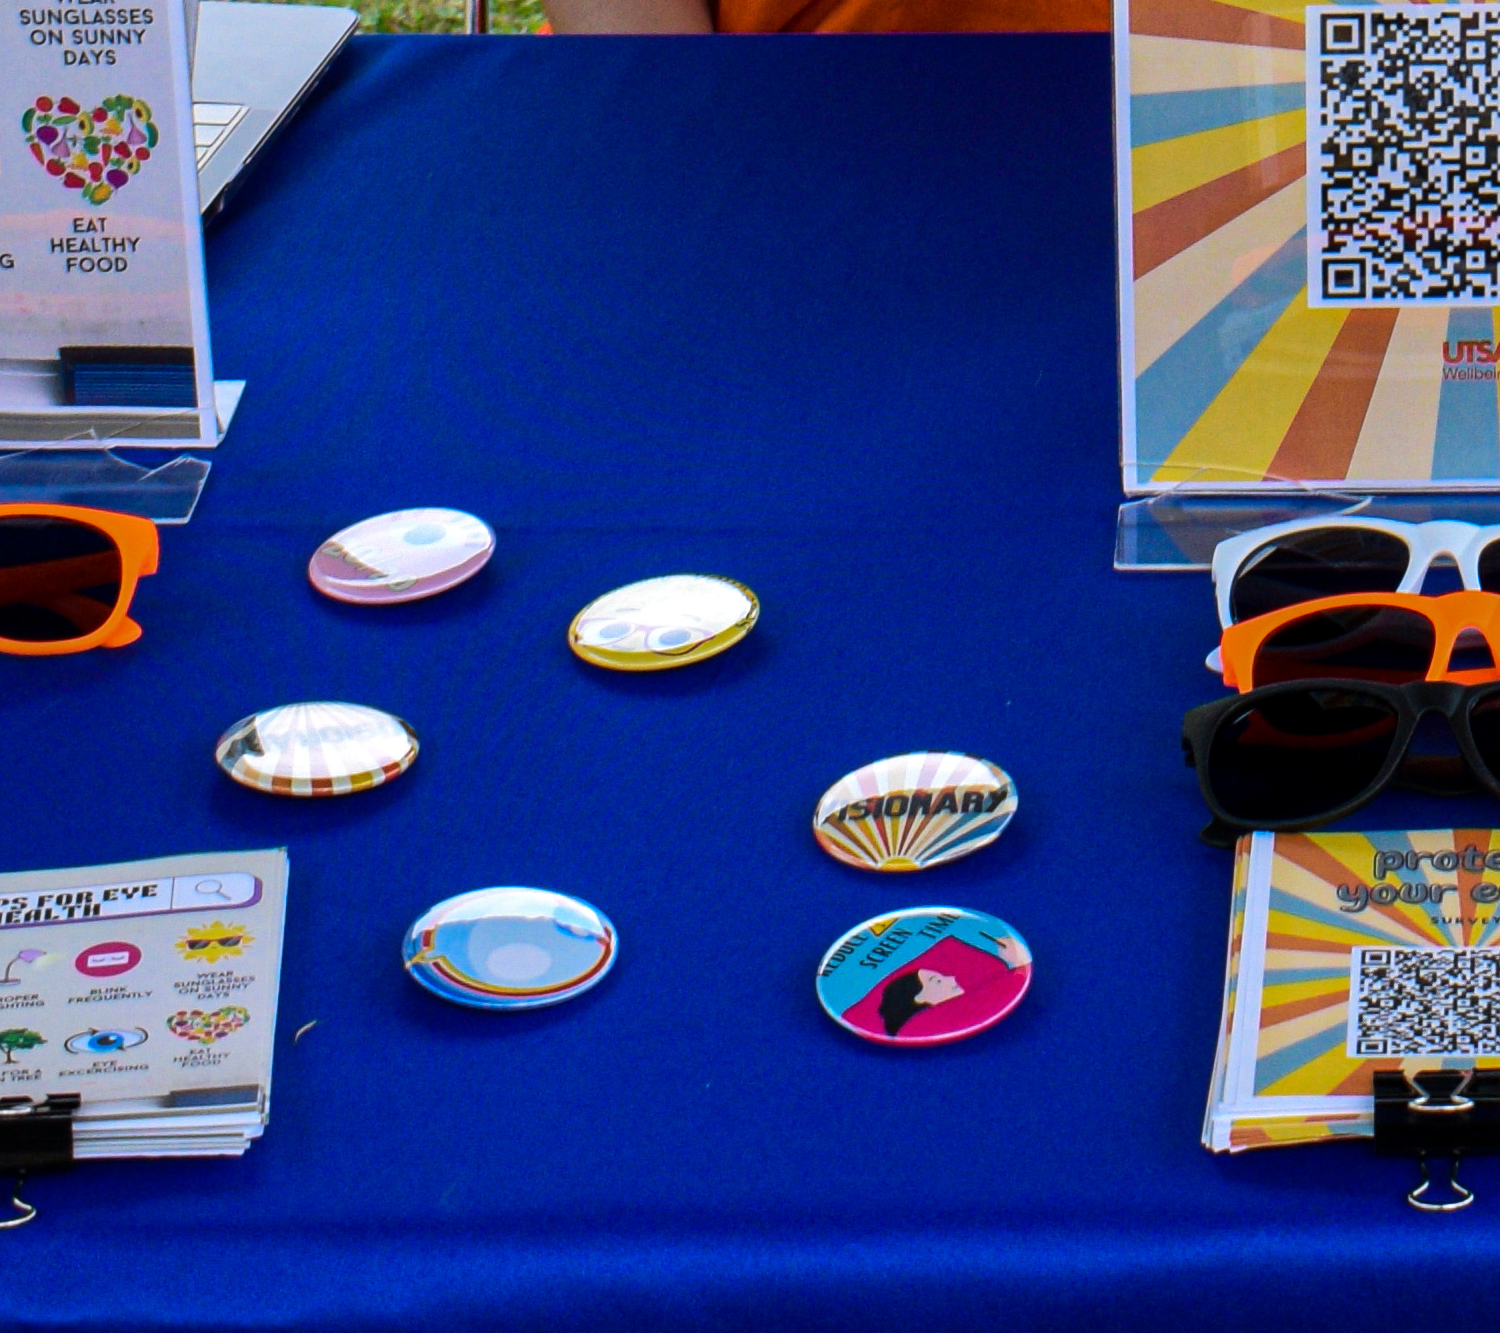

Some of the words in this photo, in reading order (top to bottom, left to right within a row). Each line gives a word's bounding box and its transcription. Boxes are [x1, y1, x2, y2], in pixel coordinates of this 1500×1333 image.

[20, 9, 154, 25] SUNGLASSES
[30, 29, 64, 46] ON
[72, 29, 146, 45] SUNNY
[64, 49, 117, 66] DAYS
[73, 217, 108, 233] EAT
[51, 237, 141, 253] HEALTHY
[66, 257, 128, 272] FOOD
[37, 890, 94, 907] FOR
[103, 884, 158, 901] EYE
[1336, 880, 1458, 913] your
[859, 926, 914, 970] SCREEN
[173, 975, 256, 988] SUNGLASSES
[68, 990, 153, 1004] FREQUENTLY
[90, 985, 128, 995] BLINK
[198, 991, 230, 1000] DAYS
[93, 1060, 117, 1068] EYE
